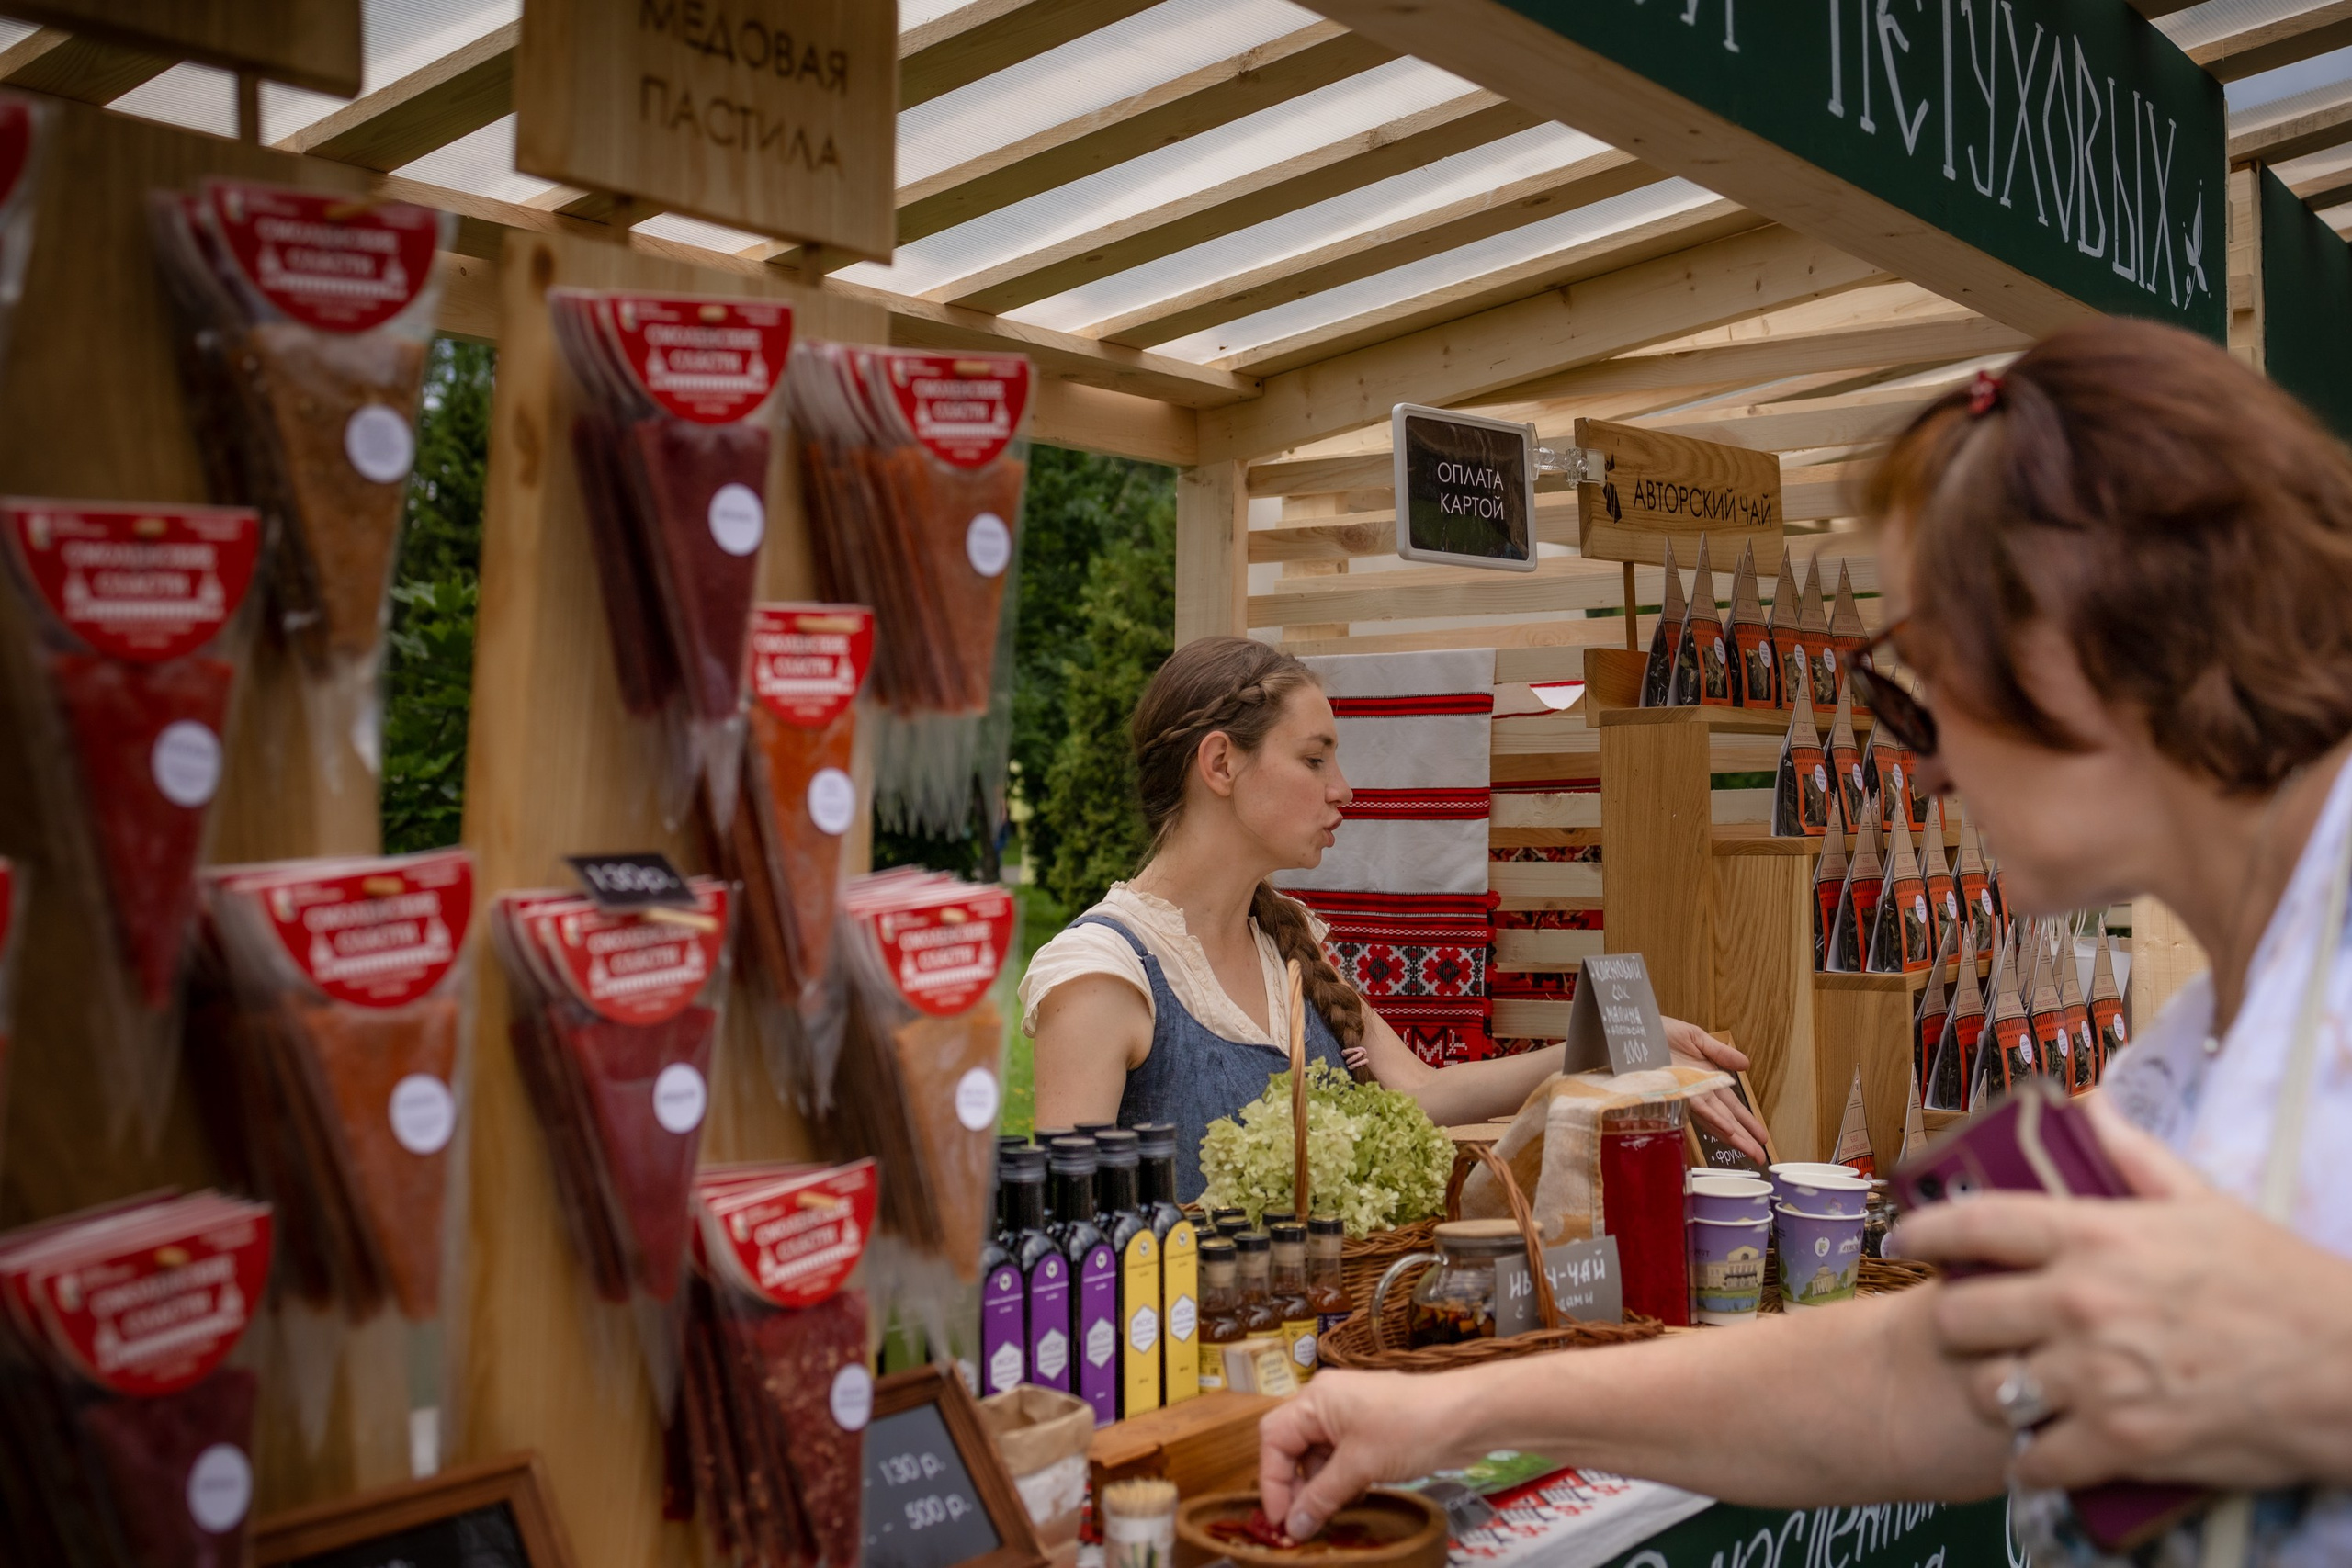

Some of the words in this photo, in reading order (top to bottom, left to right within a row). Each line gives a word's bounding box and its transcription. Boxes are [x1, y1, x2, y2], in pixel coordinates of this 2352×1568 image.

[639, 0, 848, 97] МЕДОВАЯ
[640, 73, 846, 180] ПАСТИЛА
[1438, 461, 1504, 491] ОПЛАТА
[1440, 491, 1504, 521] КАРТОЙ
[1633, 479, 1736, 524] АВТОРСКИЙ
[1739, 493, 1772, 528] ЧАЙ
